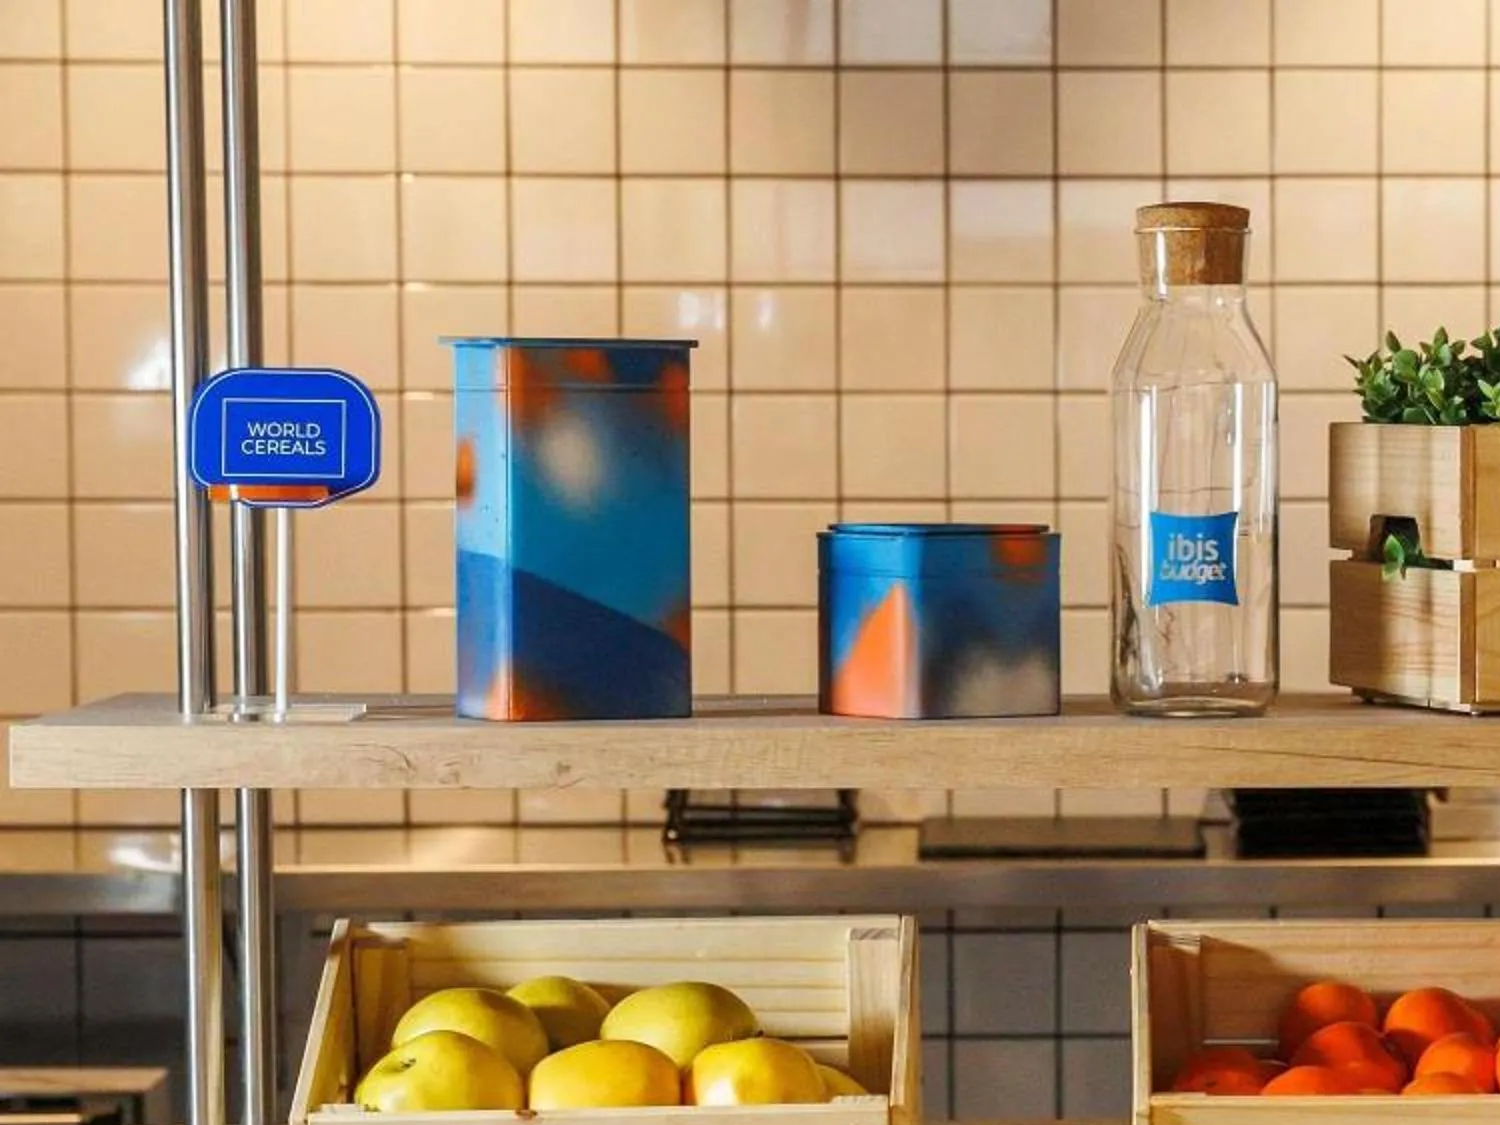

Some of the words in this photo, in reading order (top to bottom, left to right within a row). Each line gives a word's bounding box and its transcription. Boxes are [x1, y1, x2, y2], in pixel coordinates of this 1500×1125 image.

[247, 421, 321, 438] WORLD
[241, 440, 326, 456] CEREALS
[1168, 533, 1220, 561] ibis
[1160, 560, 1227, 585] budget
